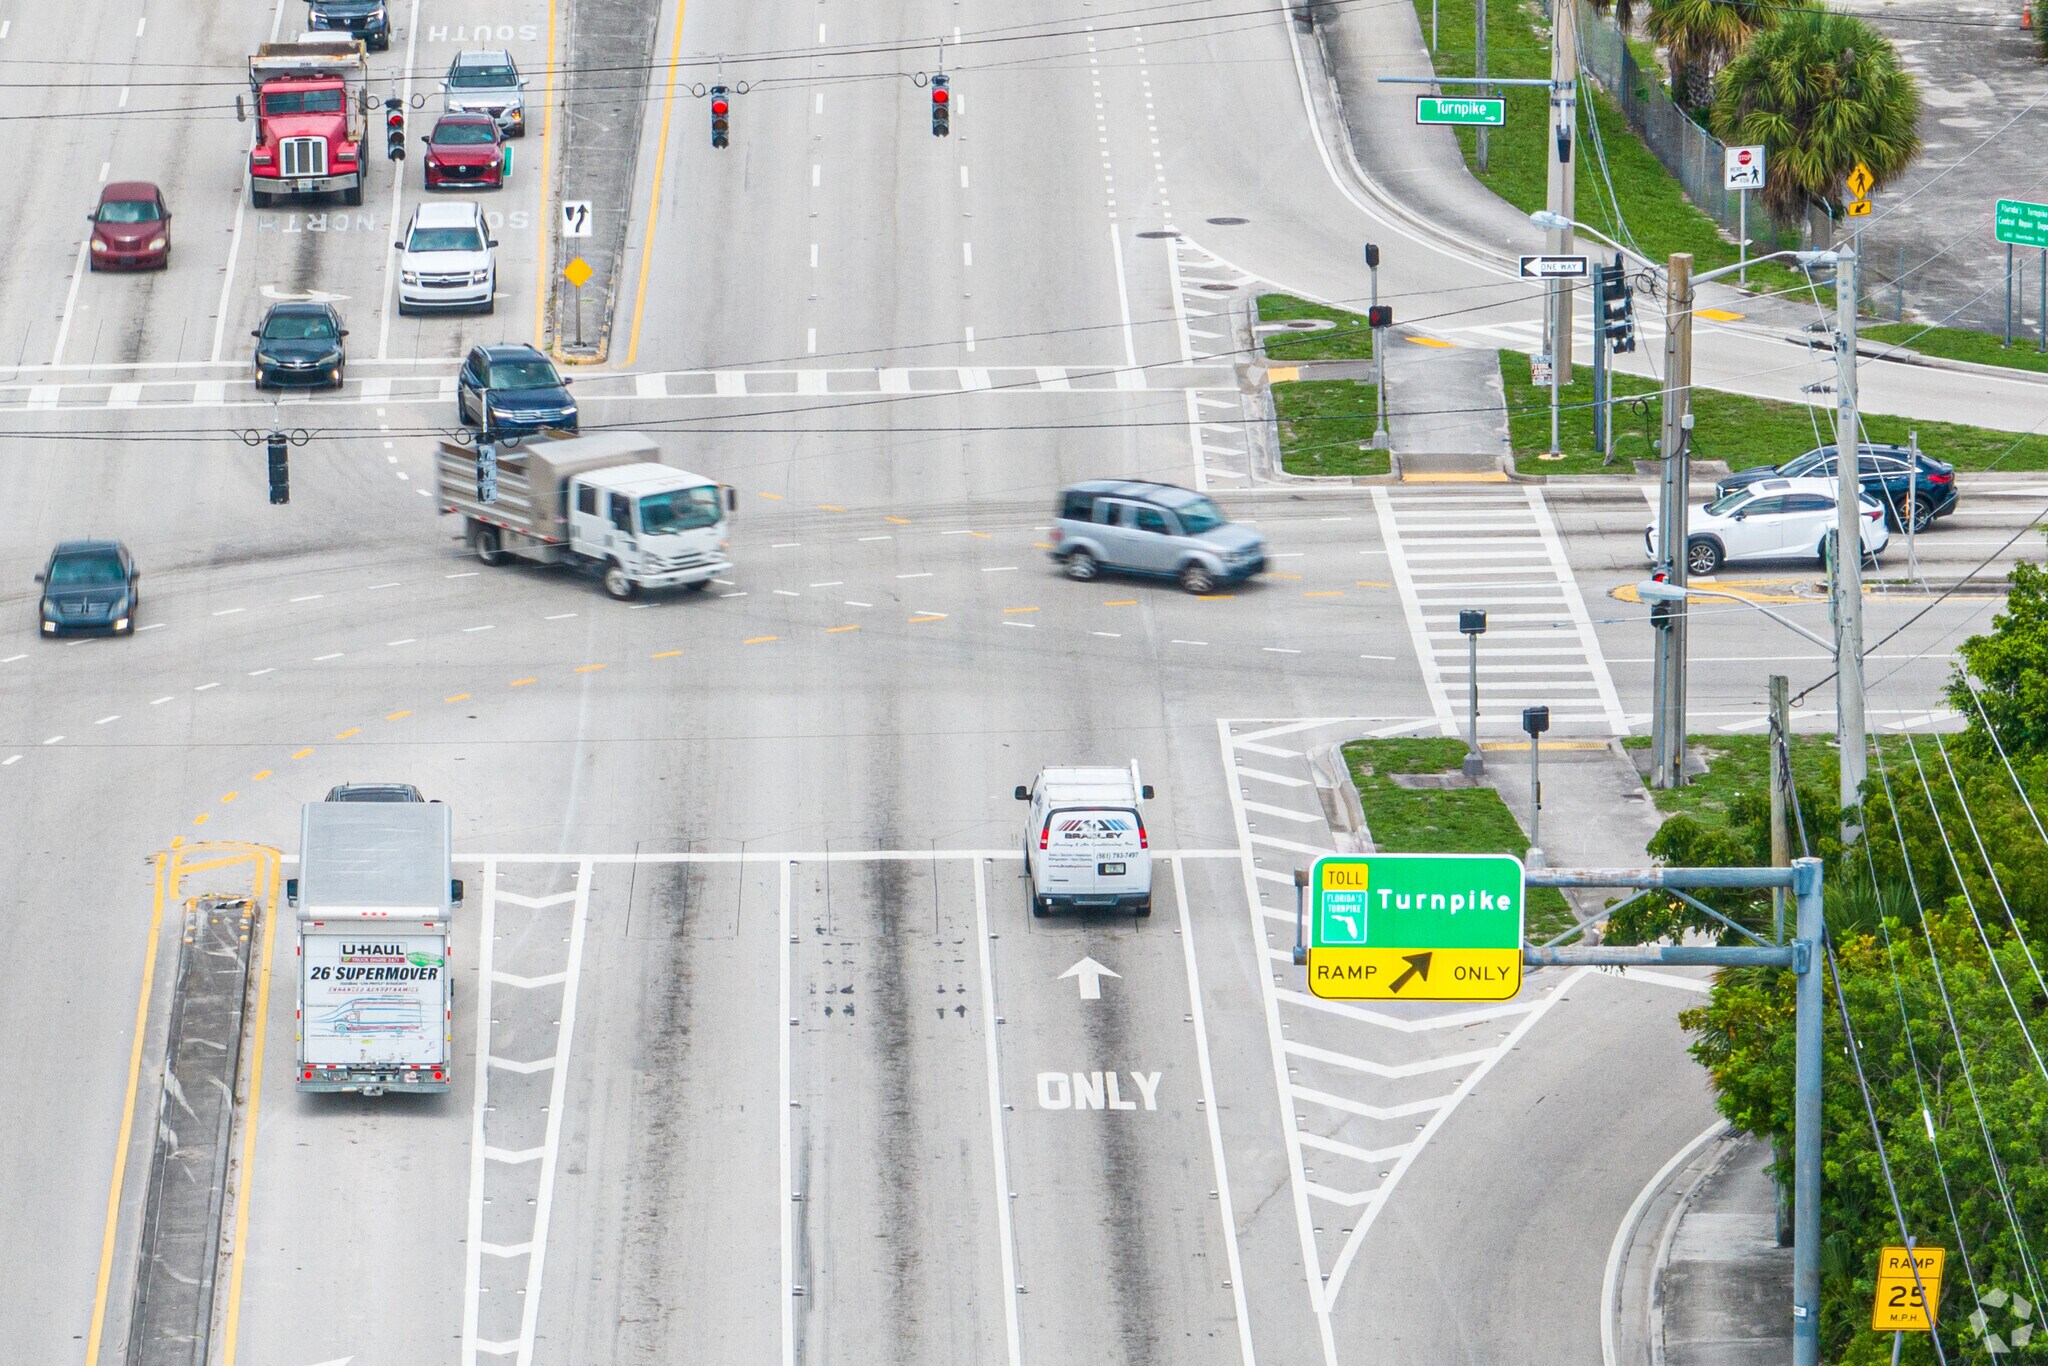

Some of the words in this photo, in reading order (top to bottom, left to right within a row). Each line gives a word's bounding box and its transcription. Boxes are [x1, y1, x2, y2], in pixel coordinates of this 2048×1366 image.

[430, 25, 537, 41] SOUTH
[1436, 100, 1487, 118] Turnpike
[257, 212, 376, 233] NORTH
[1541, 263, 1556, 271] ONE
[1560, 263, 1577, 271] WAY
[1328, 871, 1363, 885] TOLL
[1327, 893, 1362, 903] FLORIDA'S
[1377, 889, 1512, 915] Turnpike
[1328, 903, 1362, 914] TURNPIKE
[342, 944, 404, 955] U-HAUL
[335, 967, 438, 981] SUPERMOVER
[1318, 965, 1378, 980] RAMP
[1454, 965, 1510, 981] ONLY
[1037, 1071, 1162, 1111] ONLY
[1889, 1258, 1935, 1269] RAMP
[1888, 1286, 1927, 1307] 25
[1890, 1314, 1920, 1322] M.P.H.
